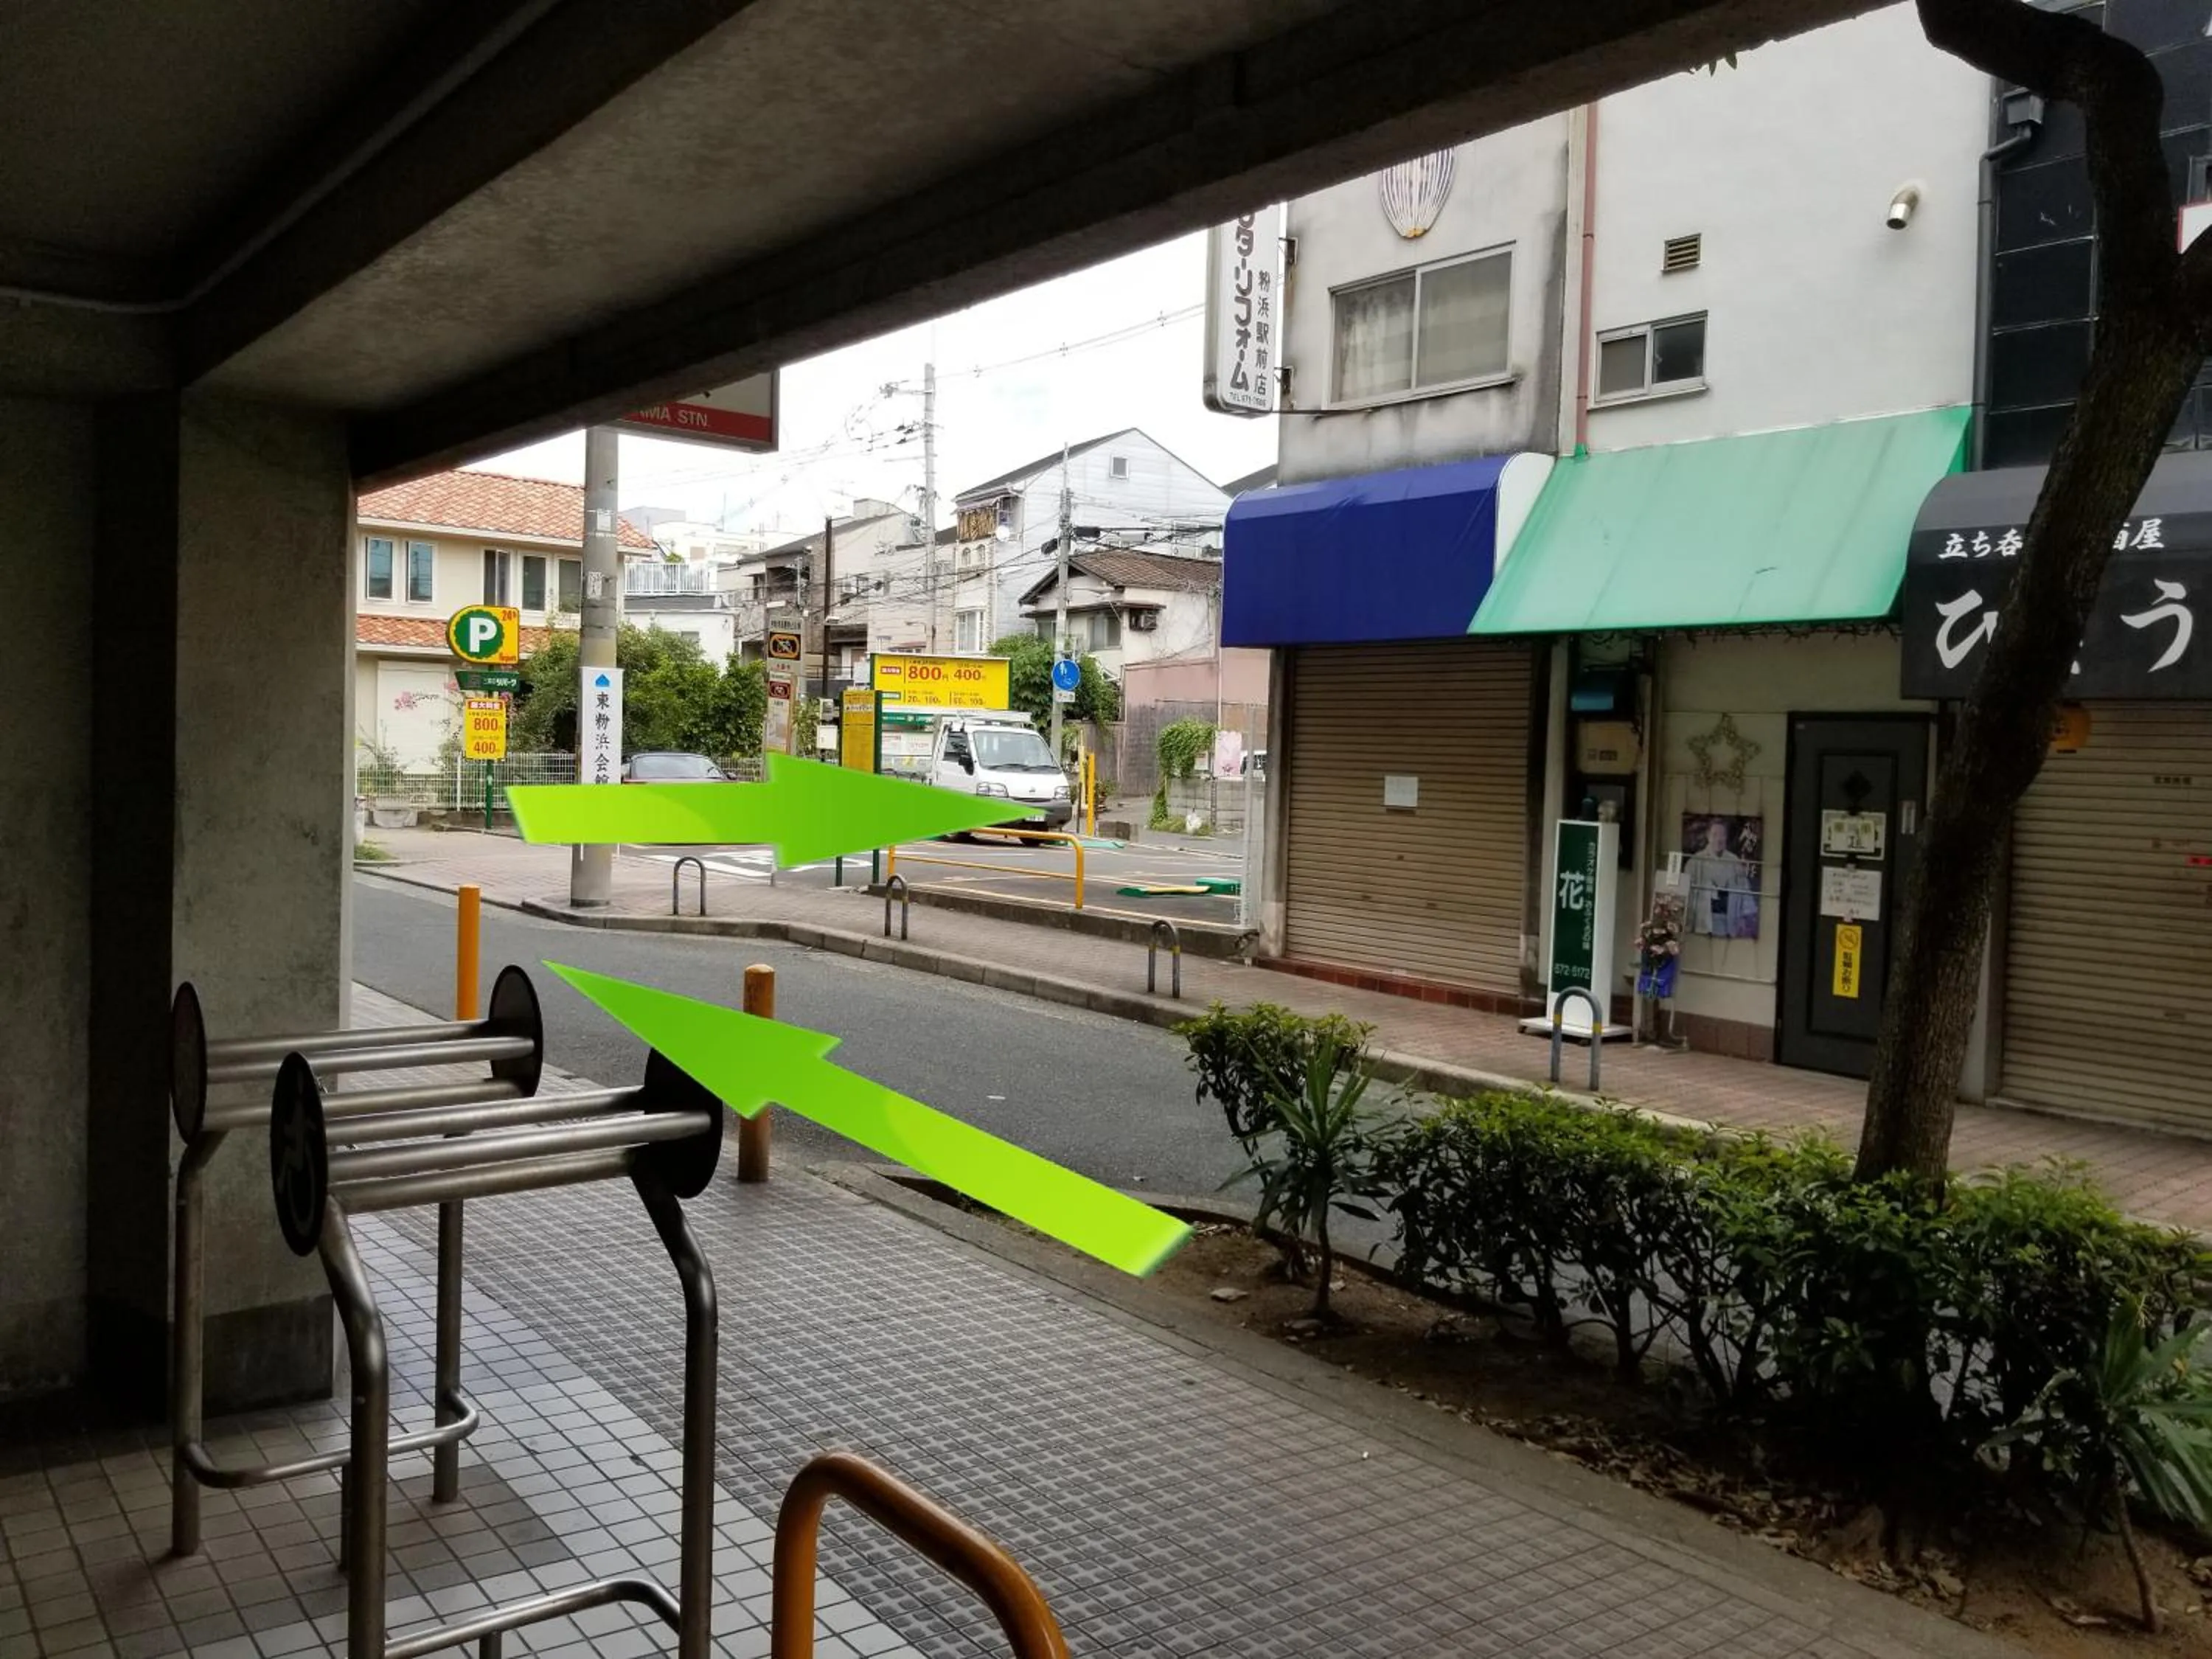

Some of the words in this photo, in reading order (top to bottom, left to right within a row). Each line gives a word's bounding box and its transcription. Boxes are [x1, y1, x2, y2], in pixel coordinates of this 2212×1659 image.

[1253, 269, 1270, 396] 粉浜駅前店
[678, 410, 708, 427] STN
[469, 617, 498, 653] P
[1935, 578, 2194, 673] ひう
[1558, 870, 1585, 911] 花
